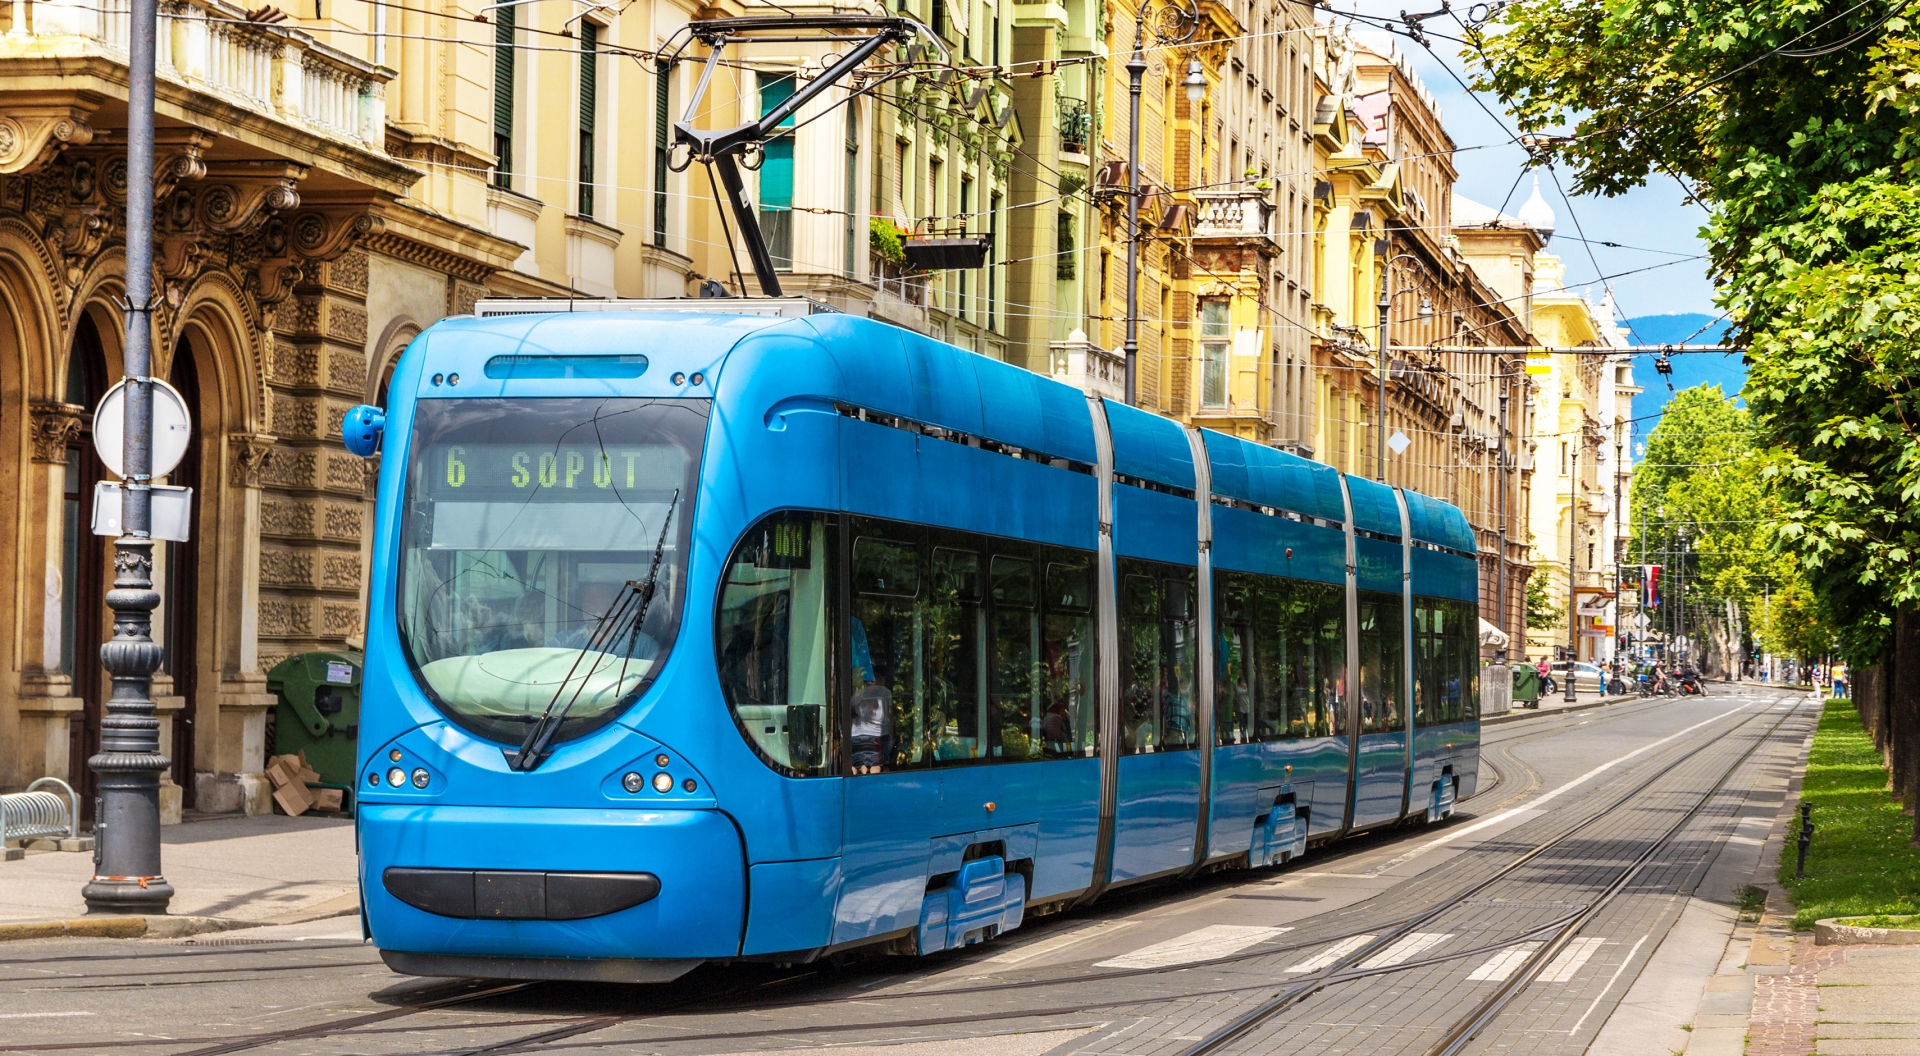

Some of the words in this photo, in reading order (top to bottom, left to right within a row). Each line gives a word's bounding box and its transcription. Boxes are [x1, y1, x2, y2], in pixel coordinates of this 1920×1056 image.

[447, 445, 466, 488] 6
[511, 451, 641, 488] SOPOT
[775, 523, 803, 557] 0611
